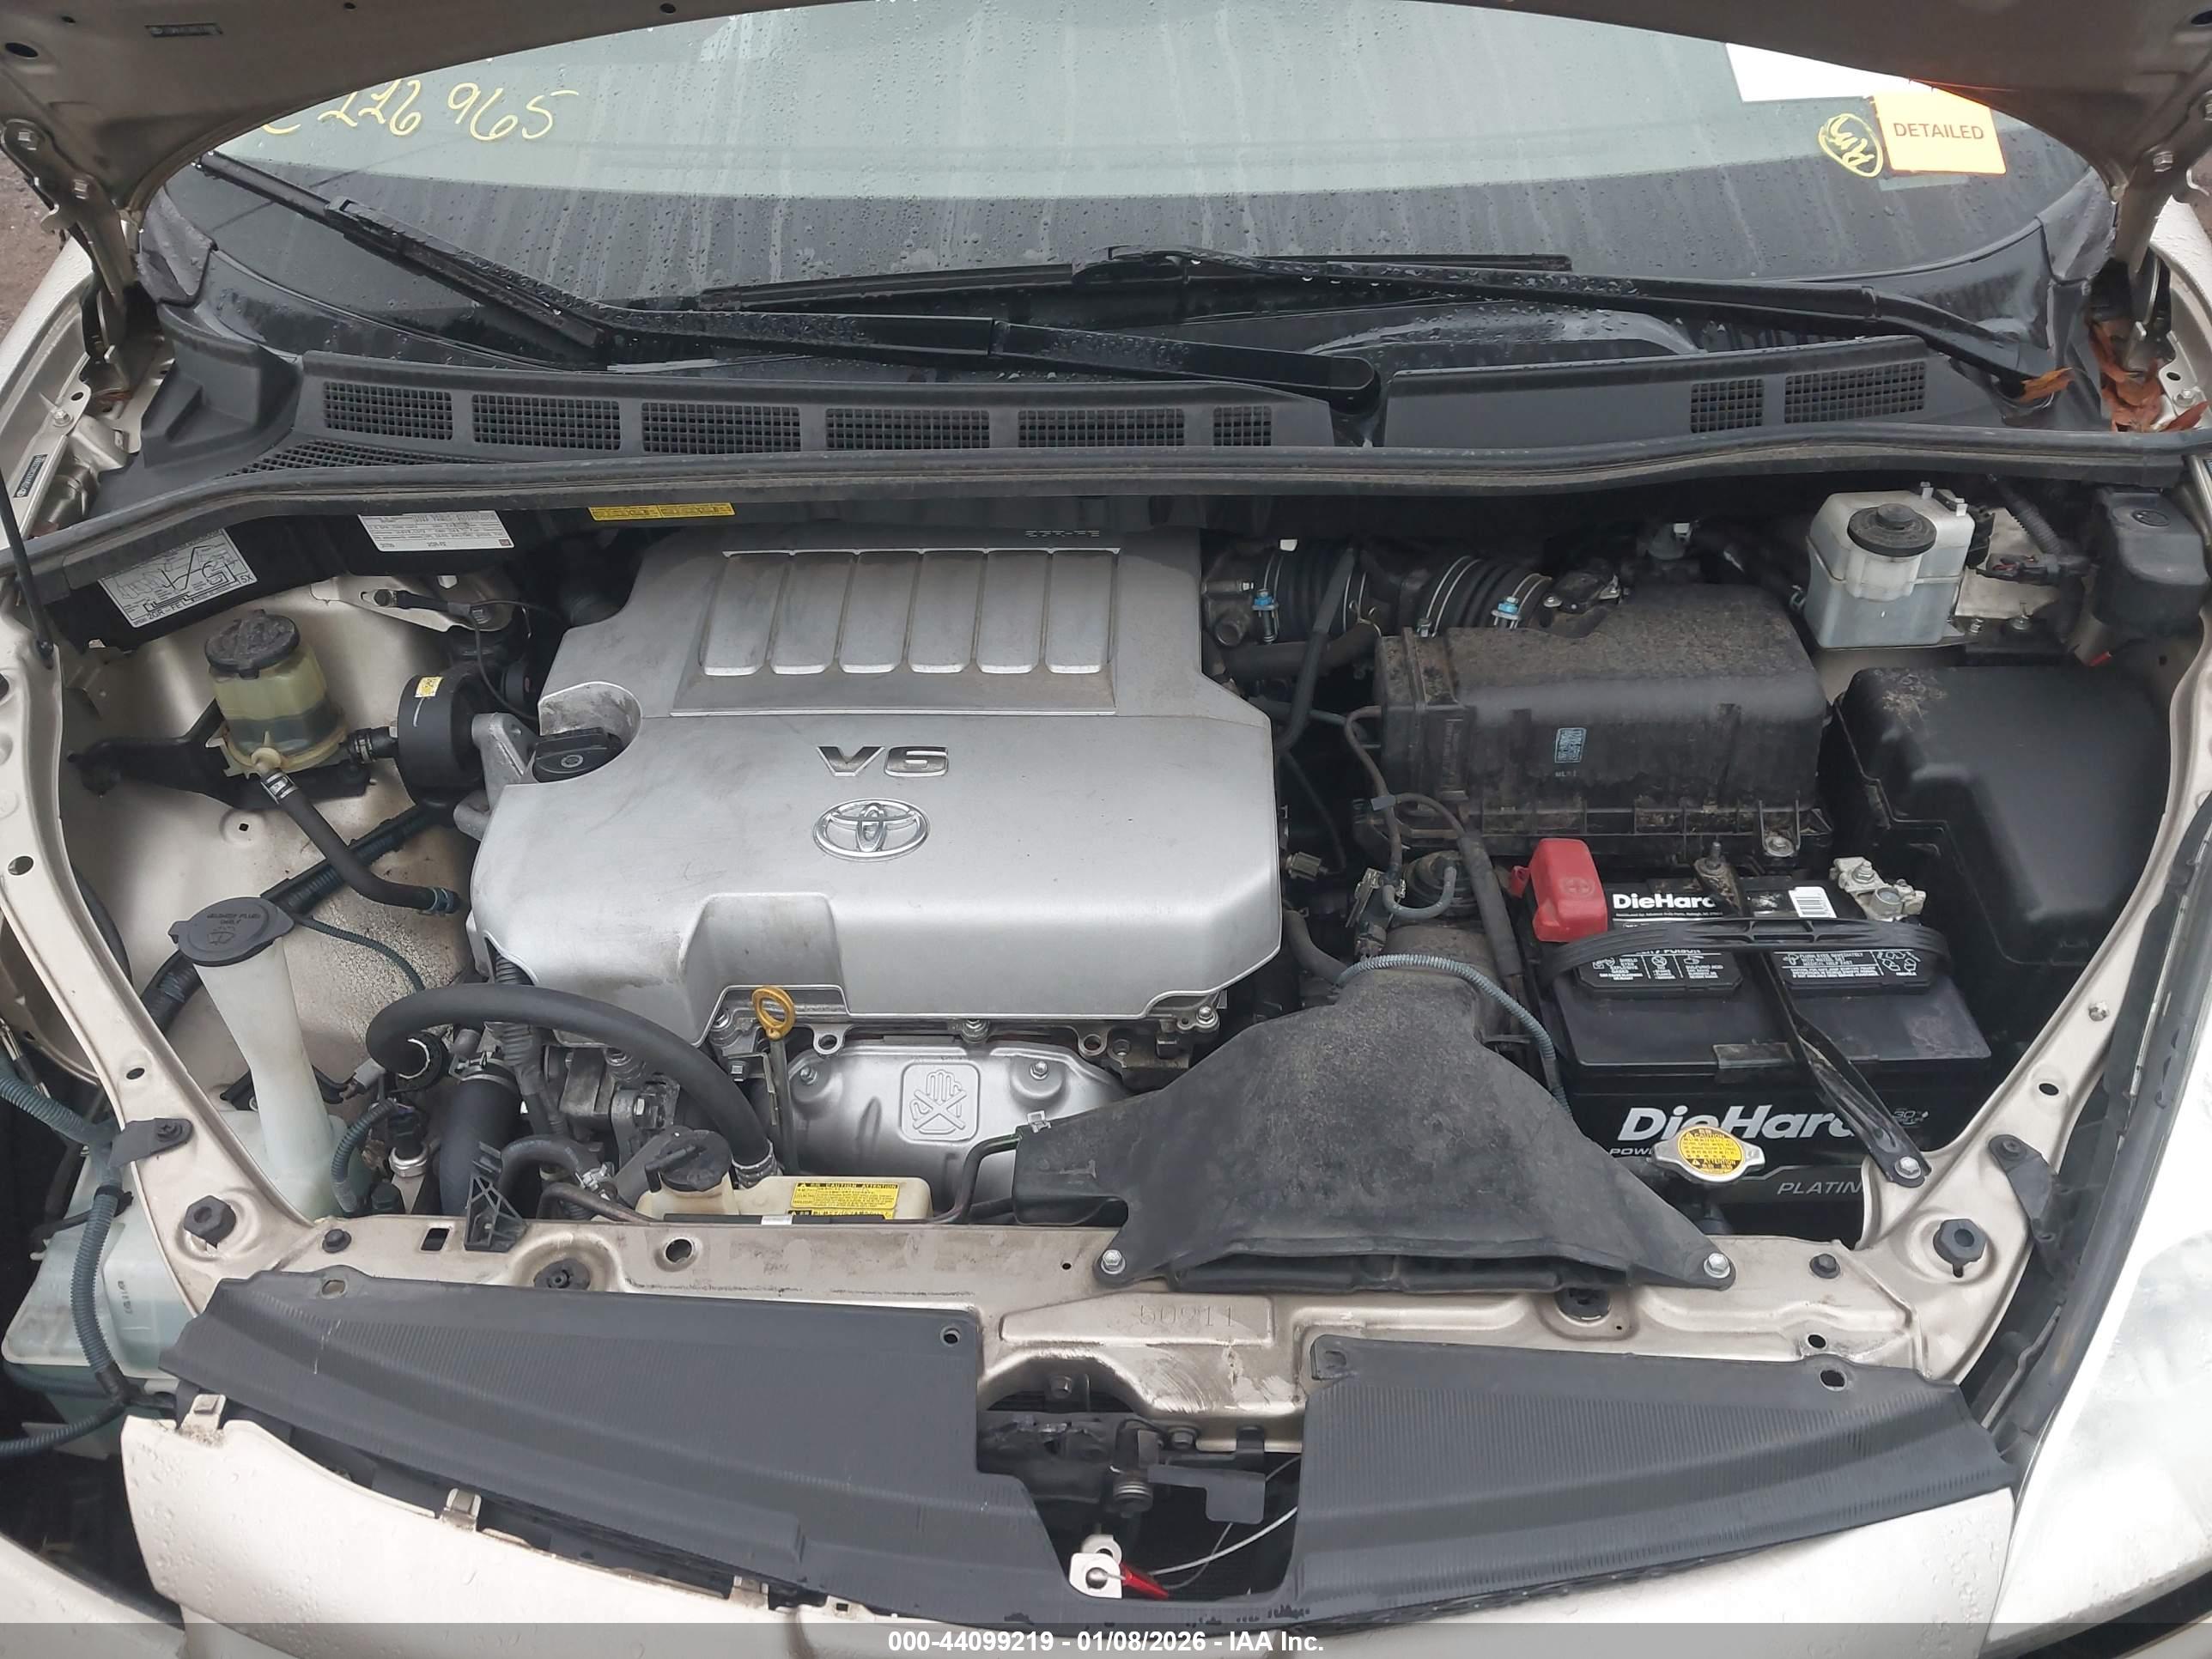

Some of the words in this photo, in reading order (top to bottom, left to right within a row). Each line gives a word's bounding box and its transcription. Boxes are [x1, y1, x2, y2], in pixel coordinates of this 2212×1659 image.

[1893, 122, 1984, 140] DETAILED
[816, 745, 949, 777] V6
[1777, 1181, 1863, 1194] PLATIN
